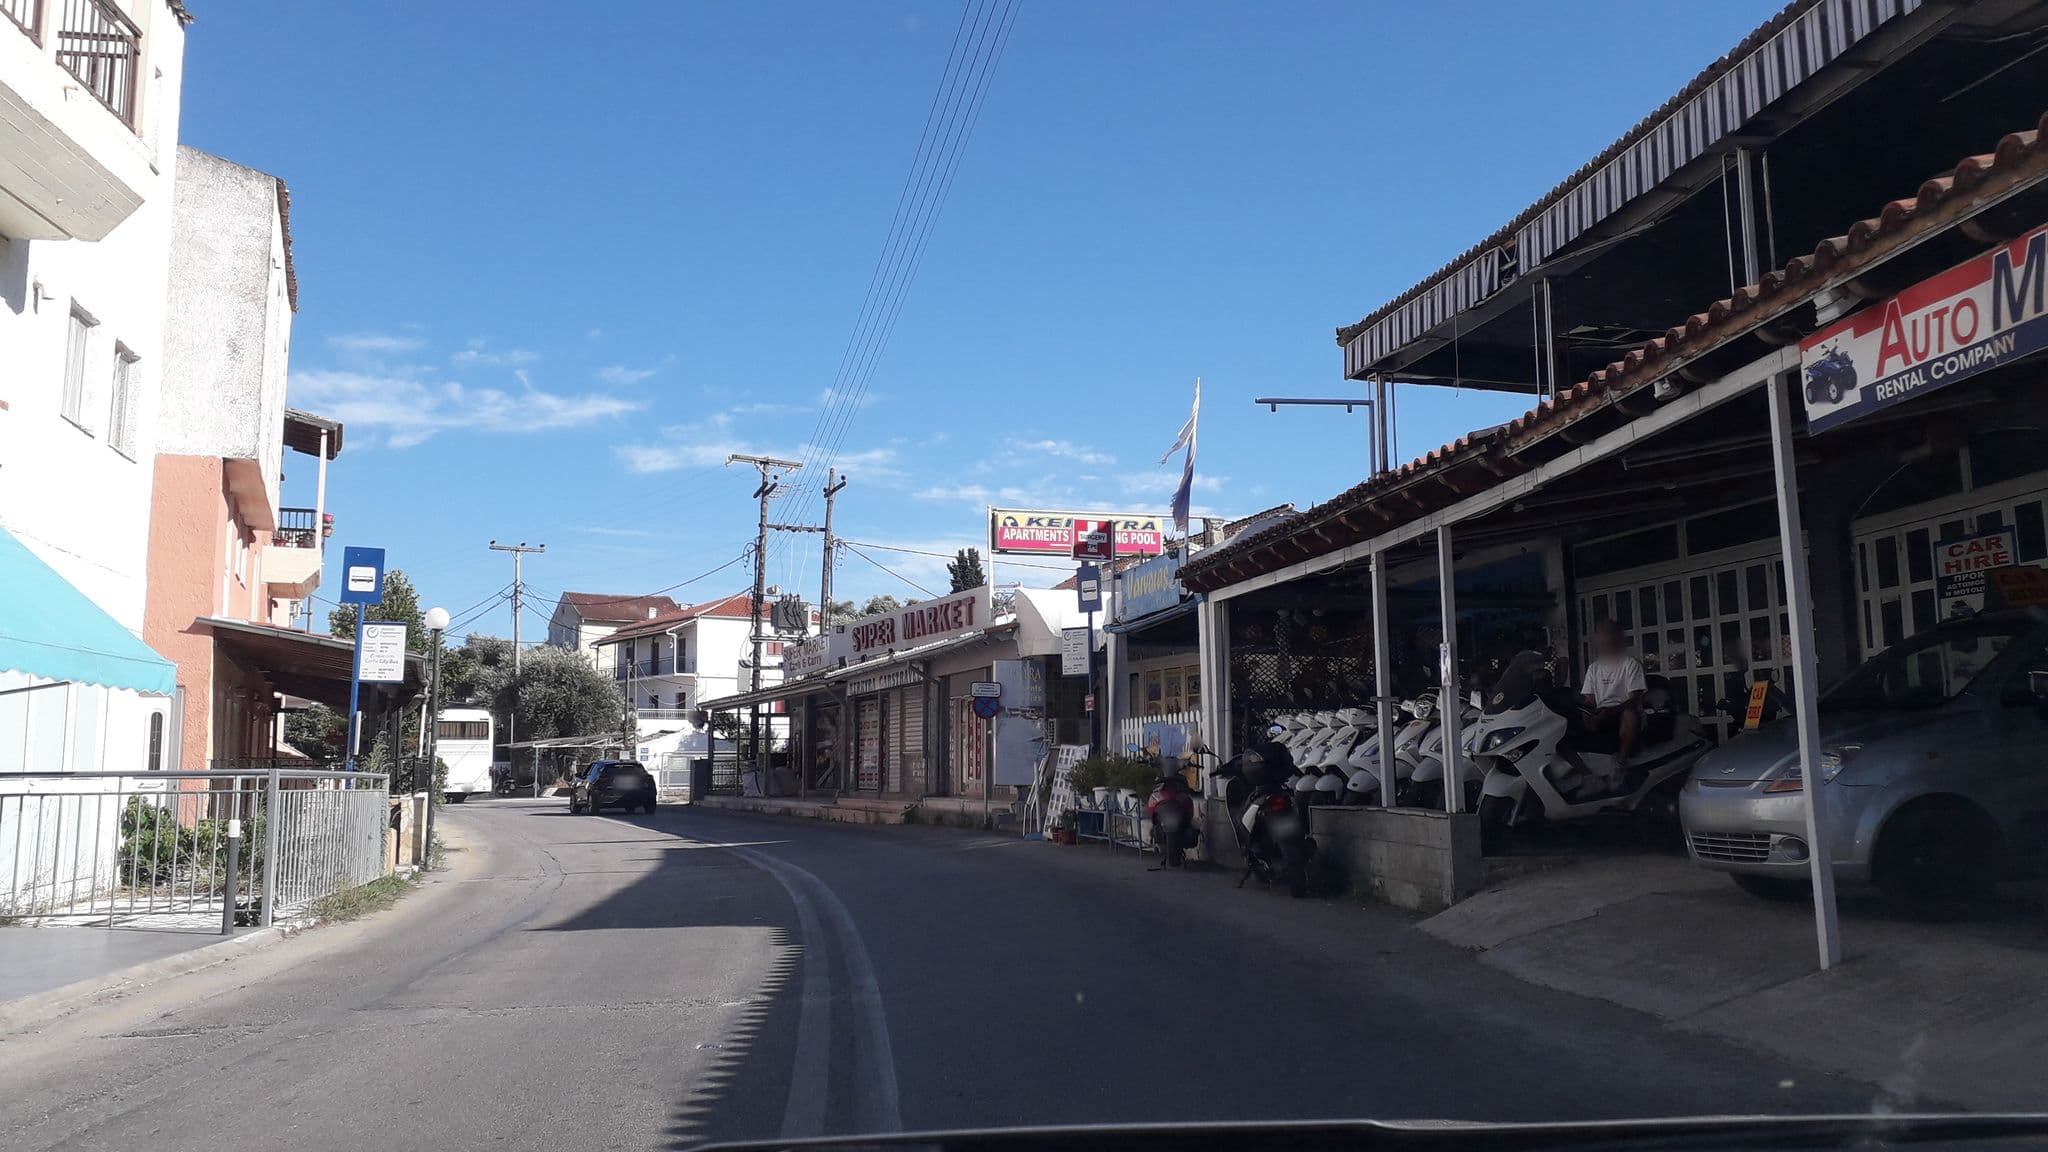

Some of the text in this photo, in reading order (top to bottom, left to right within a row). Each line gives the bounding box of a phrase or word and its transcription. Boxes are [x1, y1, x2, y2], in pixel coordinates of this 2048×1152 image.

[1875, 332, 2016, 402] RENTAL COMPANY
[1003, 528, 1069, 543] APARTMENTS
[1131, 532, 1156, 545] POOL
[1080, 533, 1106, 543] SURGERY
[1947, 535, 2004, 558] CAR
[1944, 551, 2010, 574] HIRE
[1953, 570, 1985, 582] ПРОК
[852, 596, 976, 653] SUPER MARKET
